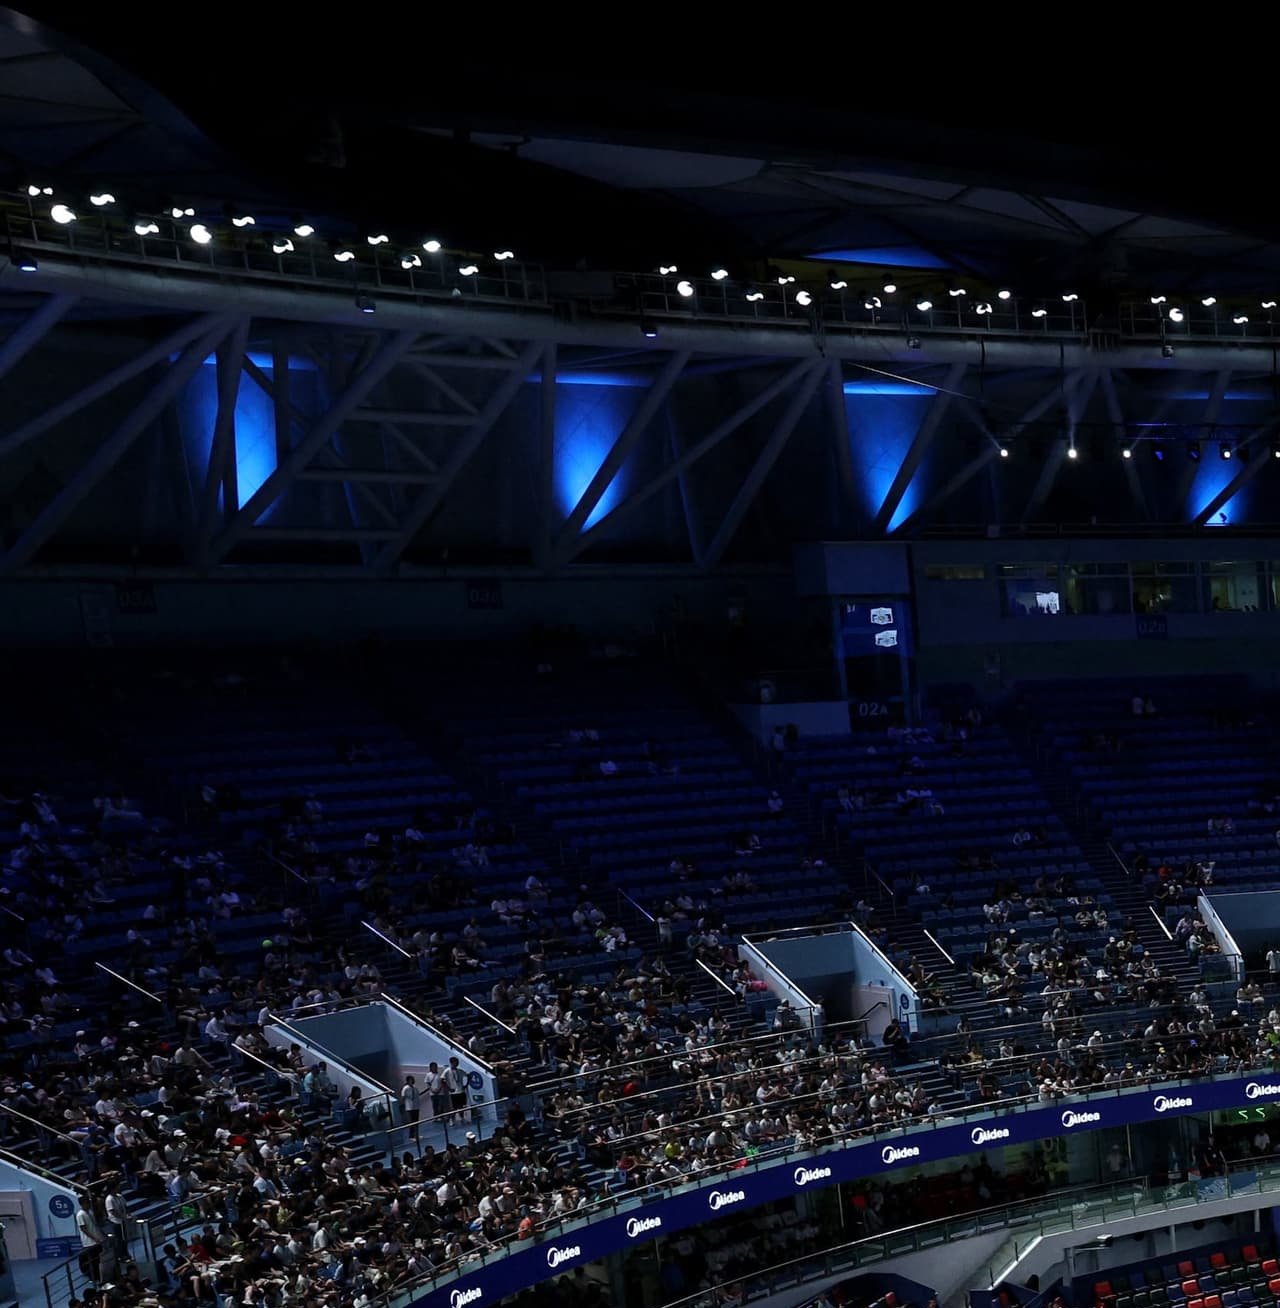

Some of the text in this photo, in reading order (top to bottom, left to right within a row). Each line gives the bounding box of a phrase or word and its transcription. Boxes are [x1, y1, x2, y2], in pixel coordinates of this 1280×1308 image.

[1154, 1096, 1192, 1112] Midea
[1062, 1111, 1100, 1127] Midea
[971, 1127, 1009, 1144] Midea
[882, 1146, 919, 1163] Midea
[794, 1167, 831, 1185] Midea
[709, 1191, 745, 1210] Midea
[627, 1217, 661, 1237] Midea
[547, 1246, 580, 1267] Midea
